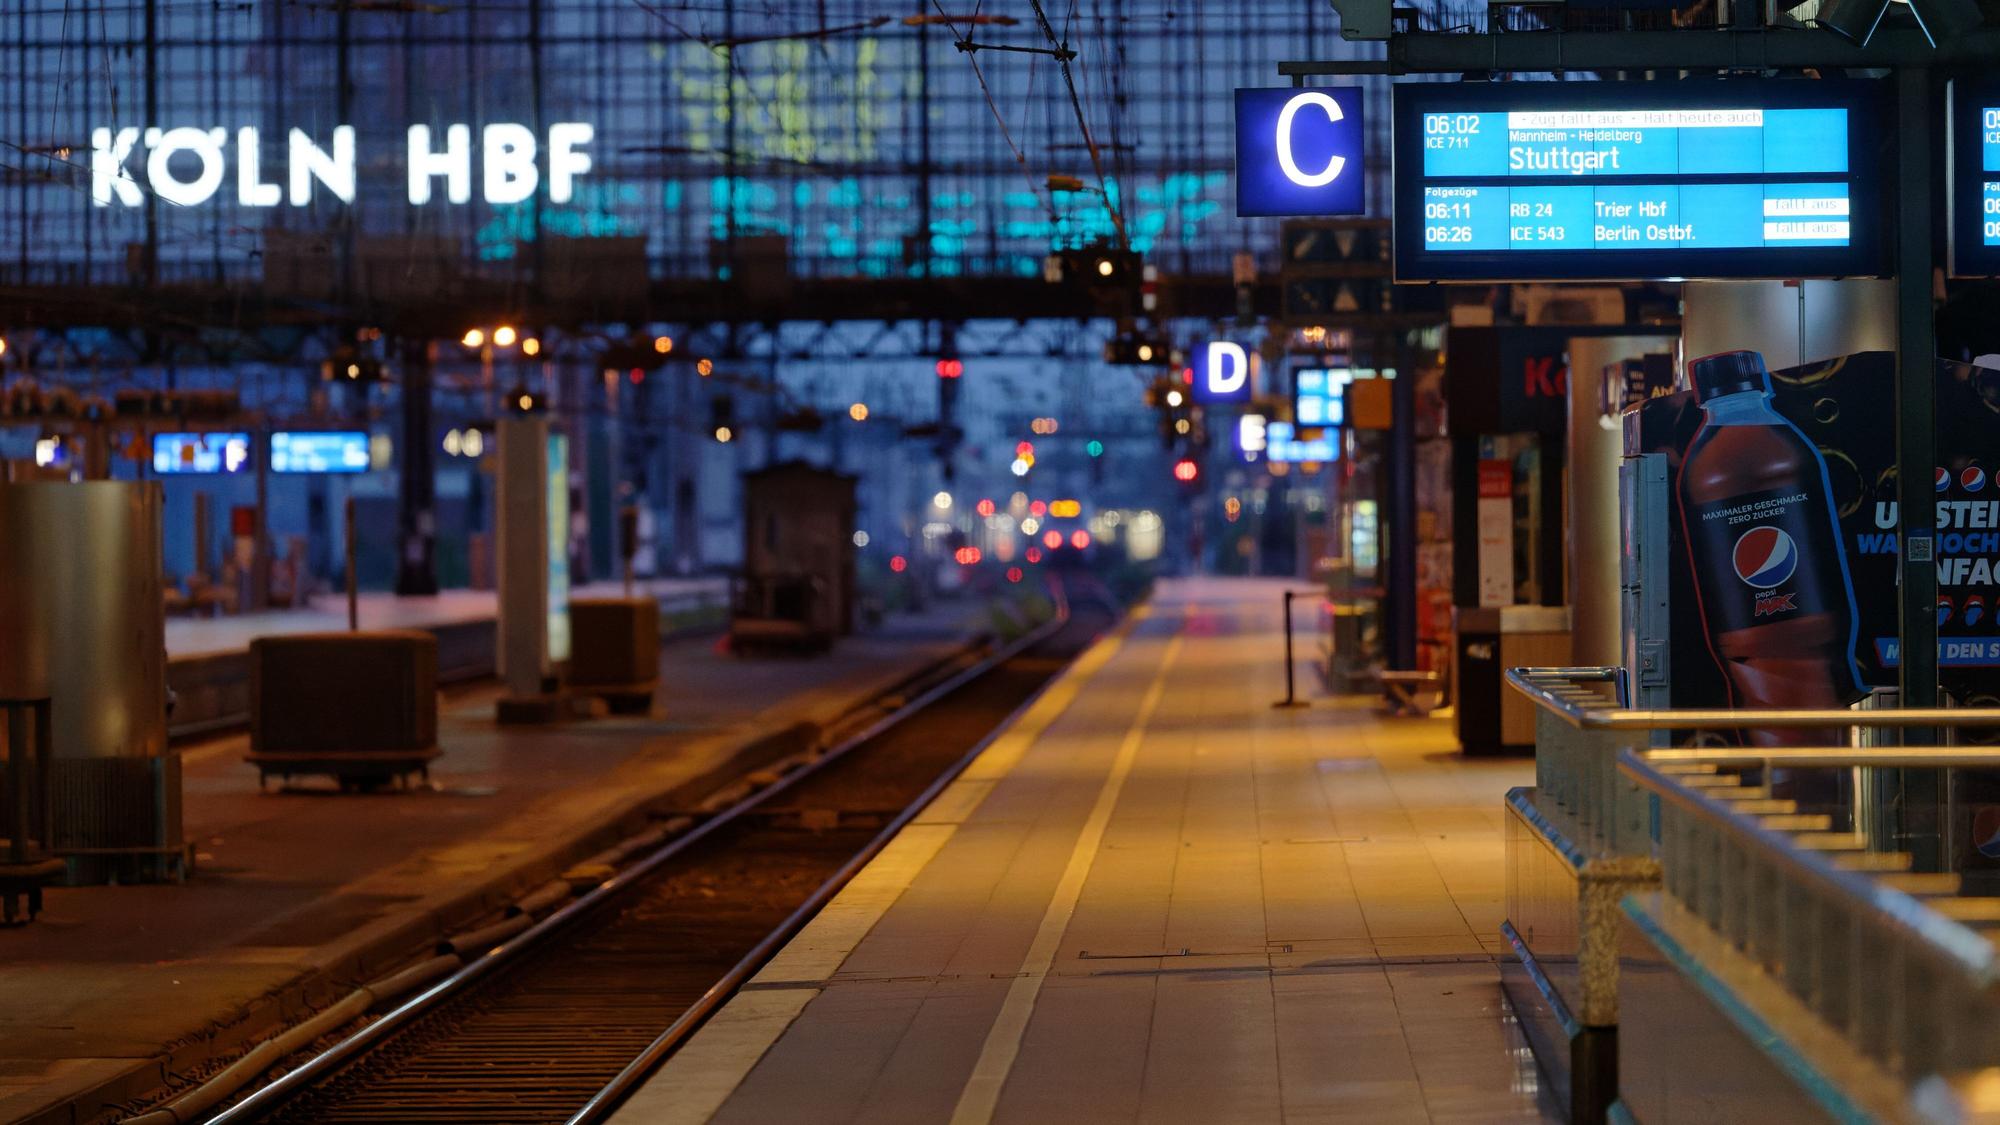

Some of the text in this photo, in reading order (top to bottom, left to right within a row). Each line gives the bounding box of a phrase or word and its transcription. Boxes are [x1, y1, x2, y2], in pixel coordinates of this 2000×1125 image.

[1426, 115, 1480, 134] 06:02
[1530, 113, 1556, 127] Zug
[1597, 114, 1624, 124] aus
[1644, 112, 1674, 123] Halt
[1678, 111, 1722, 123] heute
[1726, 111, 1761, 123] auch
[1276, 92, 1346, 187] C
[1426, 137, 1469, 149] ICE 711
[1509, 130, 1567, 142] Mannheim
[1579, 129, 1642, 144] Heidelberg
[91, 122, 595, 208] KÖLN HBF
[1510, 146, 1620, 175] Stuttgart
[1425, 187, 1478, 197] Folgezüge
[1425, 203, 1471, 219] 06:11
[1511, 203, 1552, 217] RB 24
[1595, 201, 1667, 217] Trier Hbf
[1425, 226, 1472, 242] 06:26
[1511, 226, 1565, 241] ICE 543
[1595, 225, 1696, 241] Berlin Ostbf.
[1208, 341, 1248, 393] D
[1240, 414, 1266, 451] E
[1702, 493, 1809, 521] MAXIMALER GESCHMACK
[1727, 507, 1786, 526] ZERO ZUCKER
[1755, 588, 1777, 601] pepsi
[1946, 643, 1984, 660] DEN
